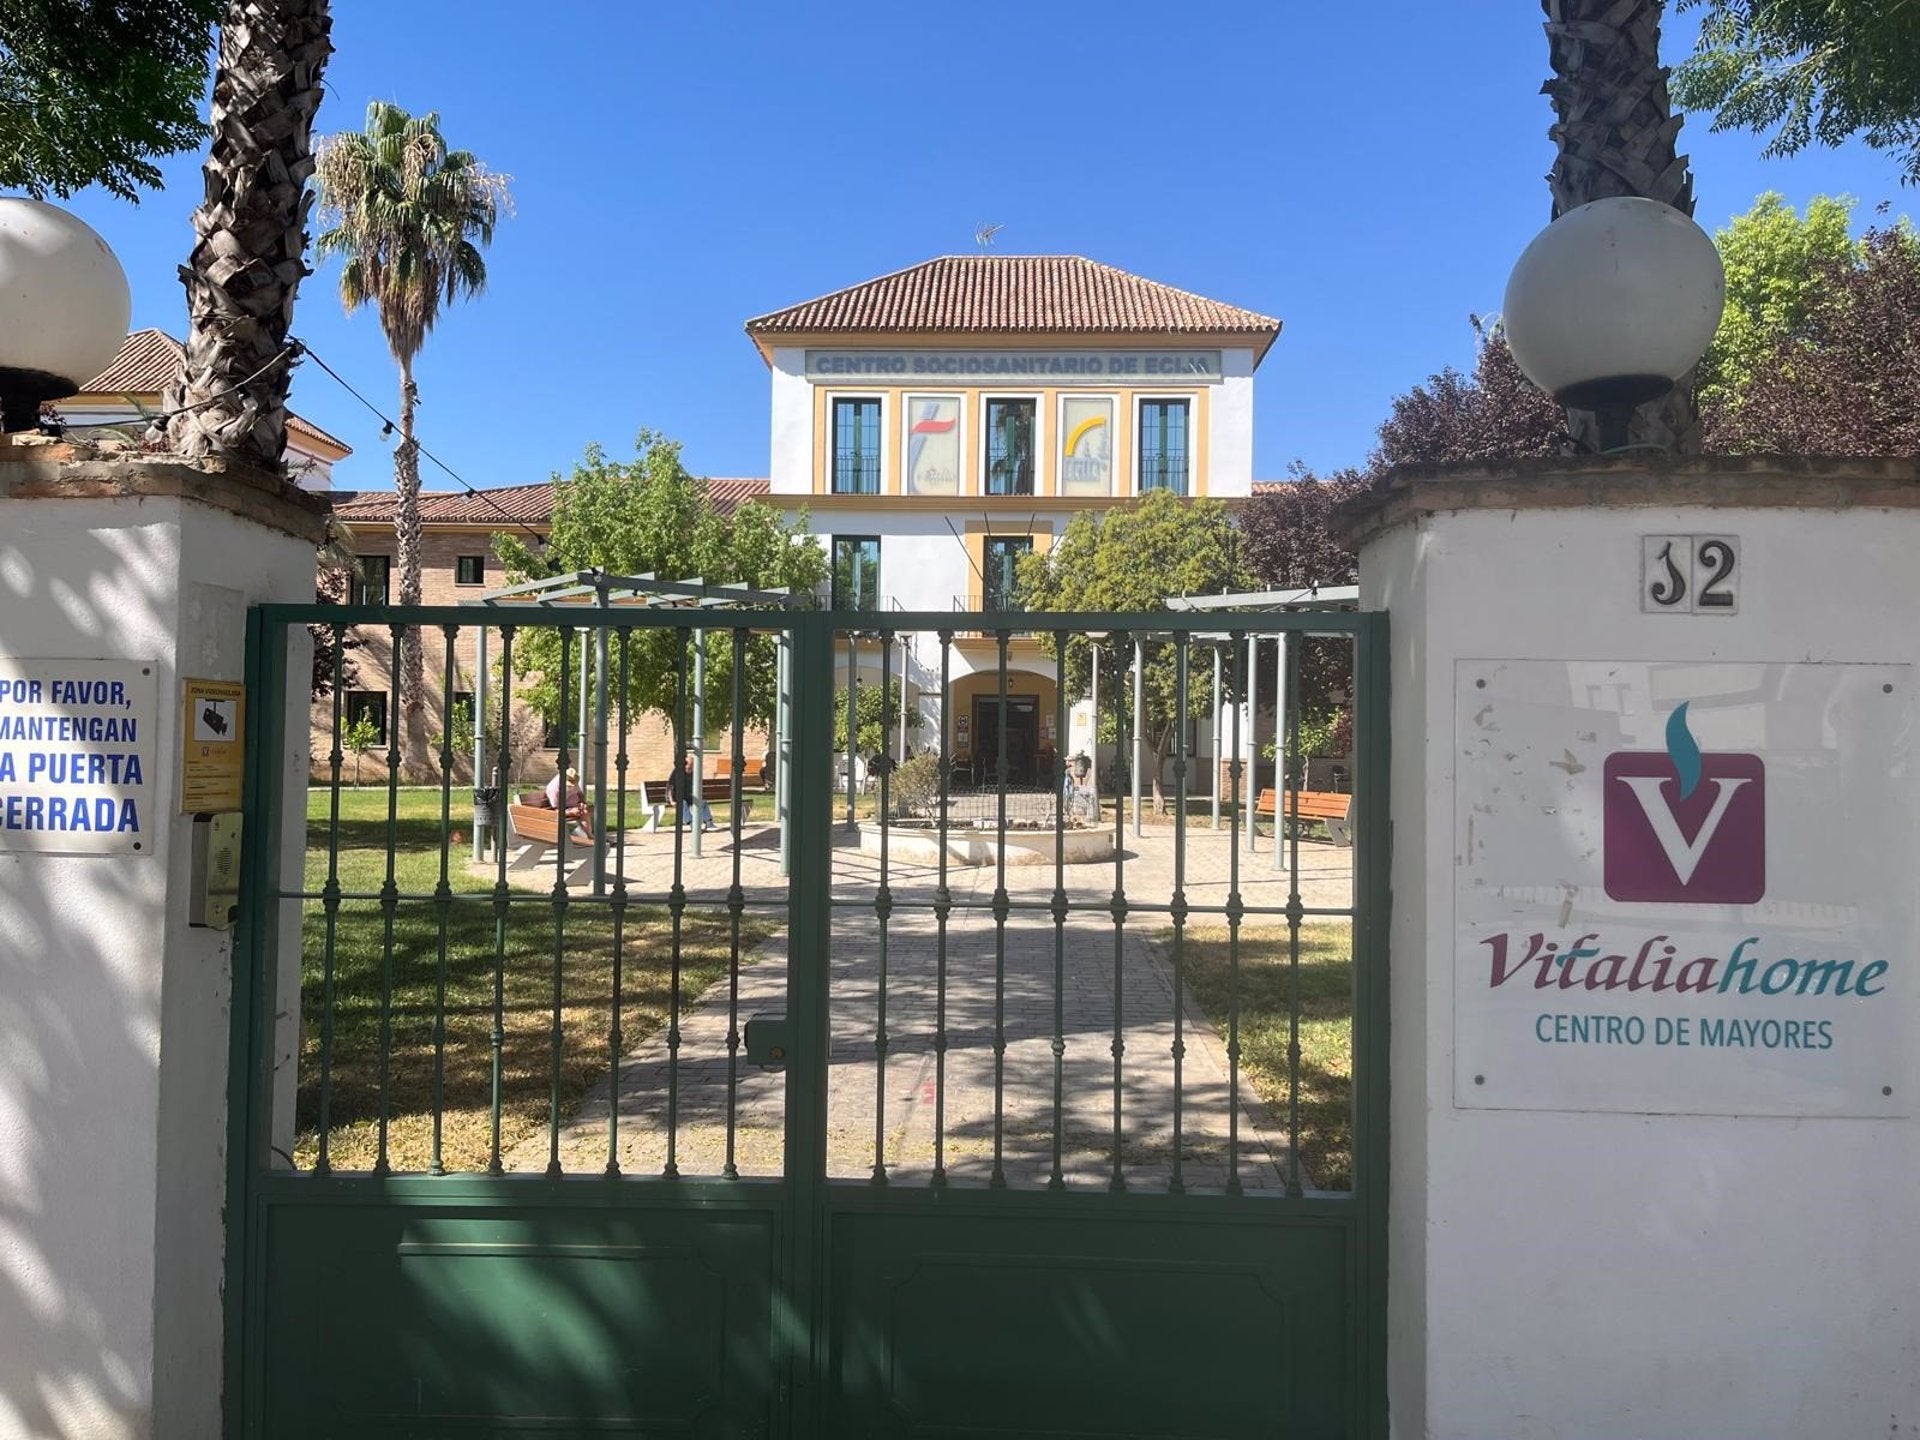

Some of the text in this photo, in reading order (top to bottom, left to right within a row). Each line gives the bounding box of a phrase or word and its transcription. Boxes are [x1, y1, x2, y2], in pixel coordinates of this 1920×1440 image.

[817, 358, 907, 374] CENTRO
[912, 357, 1102, 374] SOCIOSANITARIO
[1109, 357, 1137, 374] DE
[51, 681, 131, 709] FAVOR,
[29, 754, 143, 784] PUERTA
[0, 796, 140, 832] ERRADA
[1480, 932, 1889, 997] Vitaliahome
[1535, 1014, 1833, 1050] CENTRO DE MAYORES
